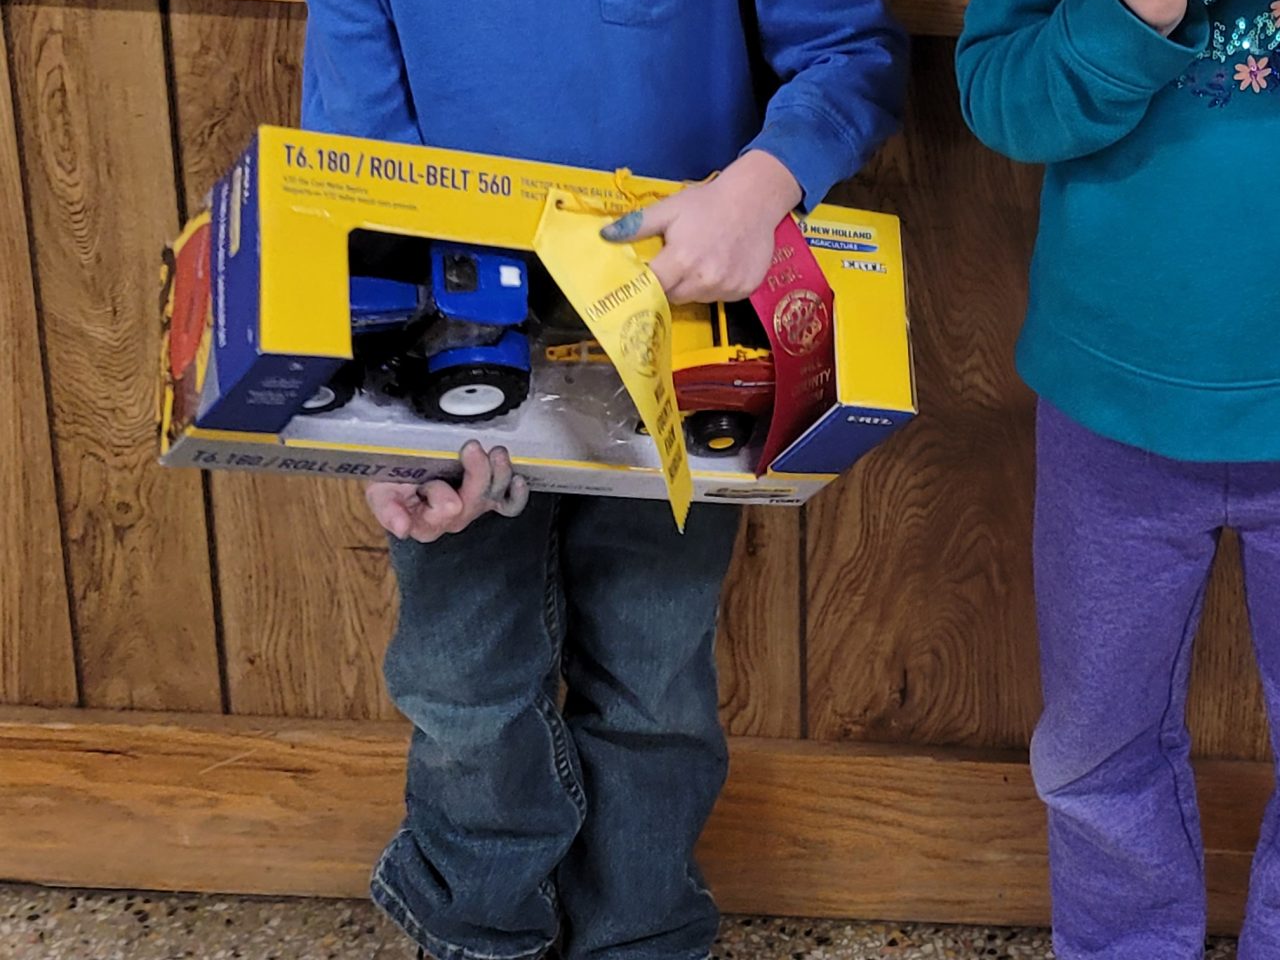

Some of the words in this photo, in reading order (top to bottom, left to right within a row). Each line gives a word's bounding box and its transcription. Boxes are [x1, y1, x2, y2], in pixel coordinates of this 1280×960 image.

[284, 144, 350, 174] T6.180
[355, 152, 365, 178] /
[370, 156, 470, 192] ROLL-BELT
[478, 172, 512, 196] 560
[810, 225, 830, 235] NEW
[831, 228, 872, 240] HOLLAND
[585, 271, 652, 322] PARTICIPANT
[278, 457, 386, 476] ROLL-BELT
[388, 467, 428, 480] 560
